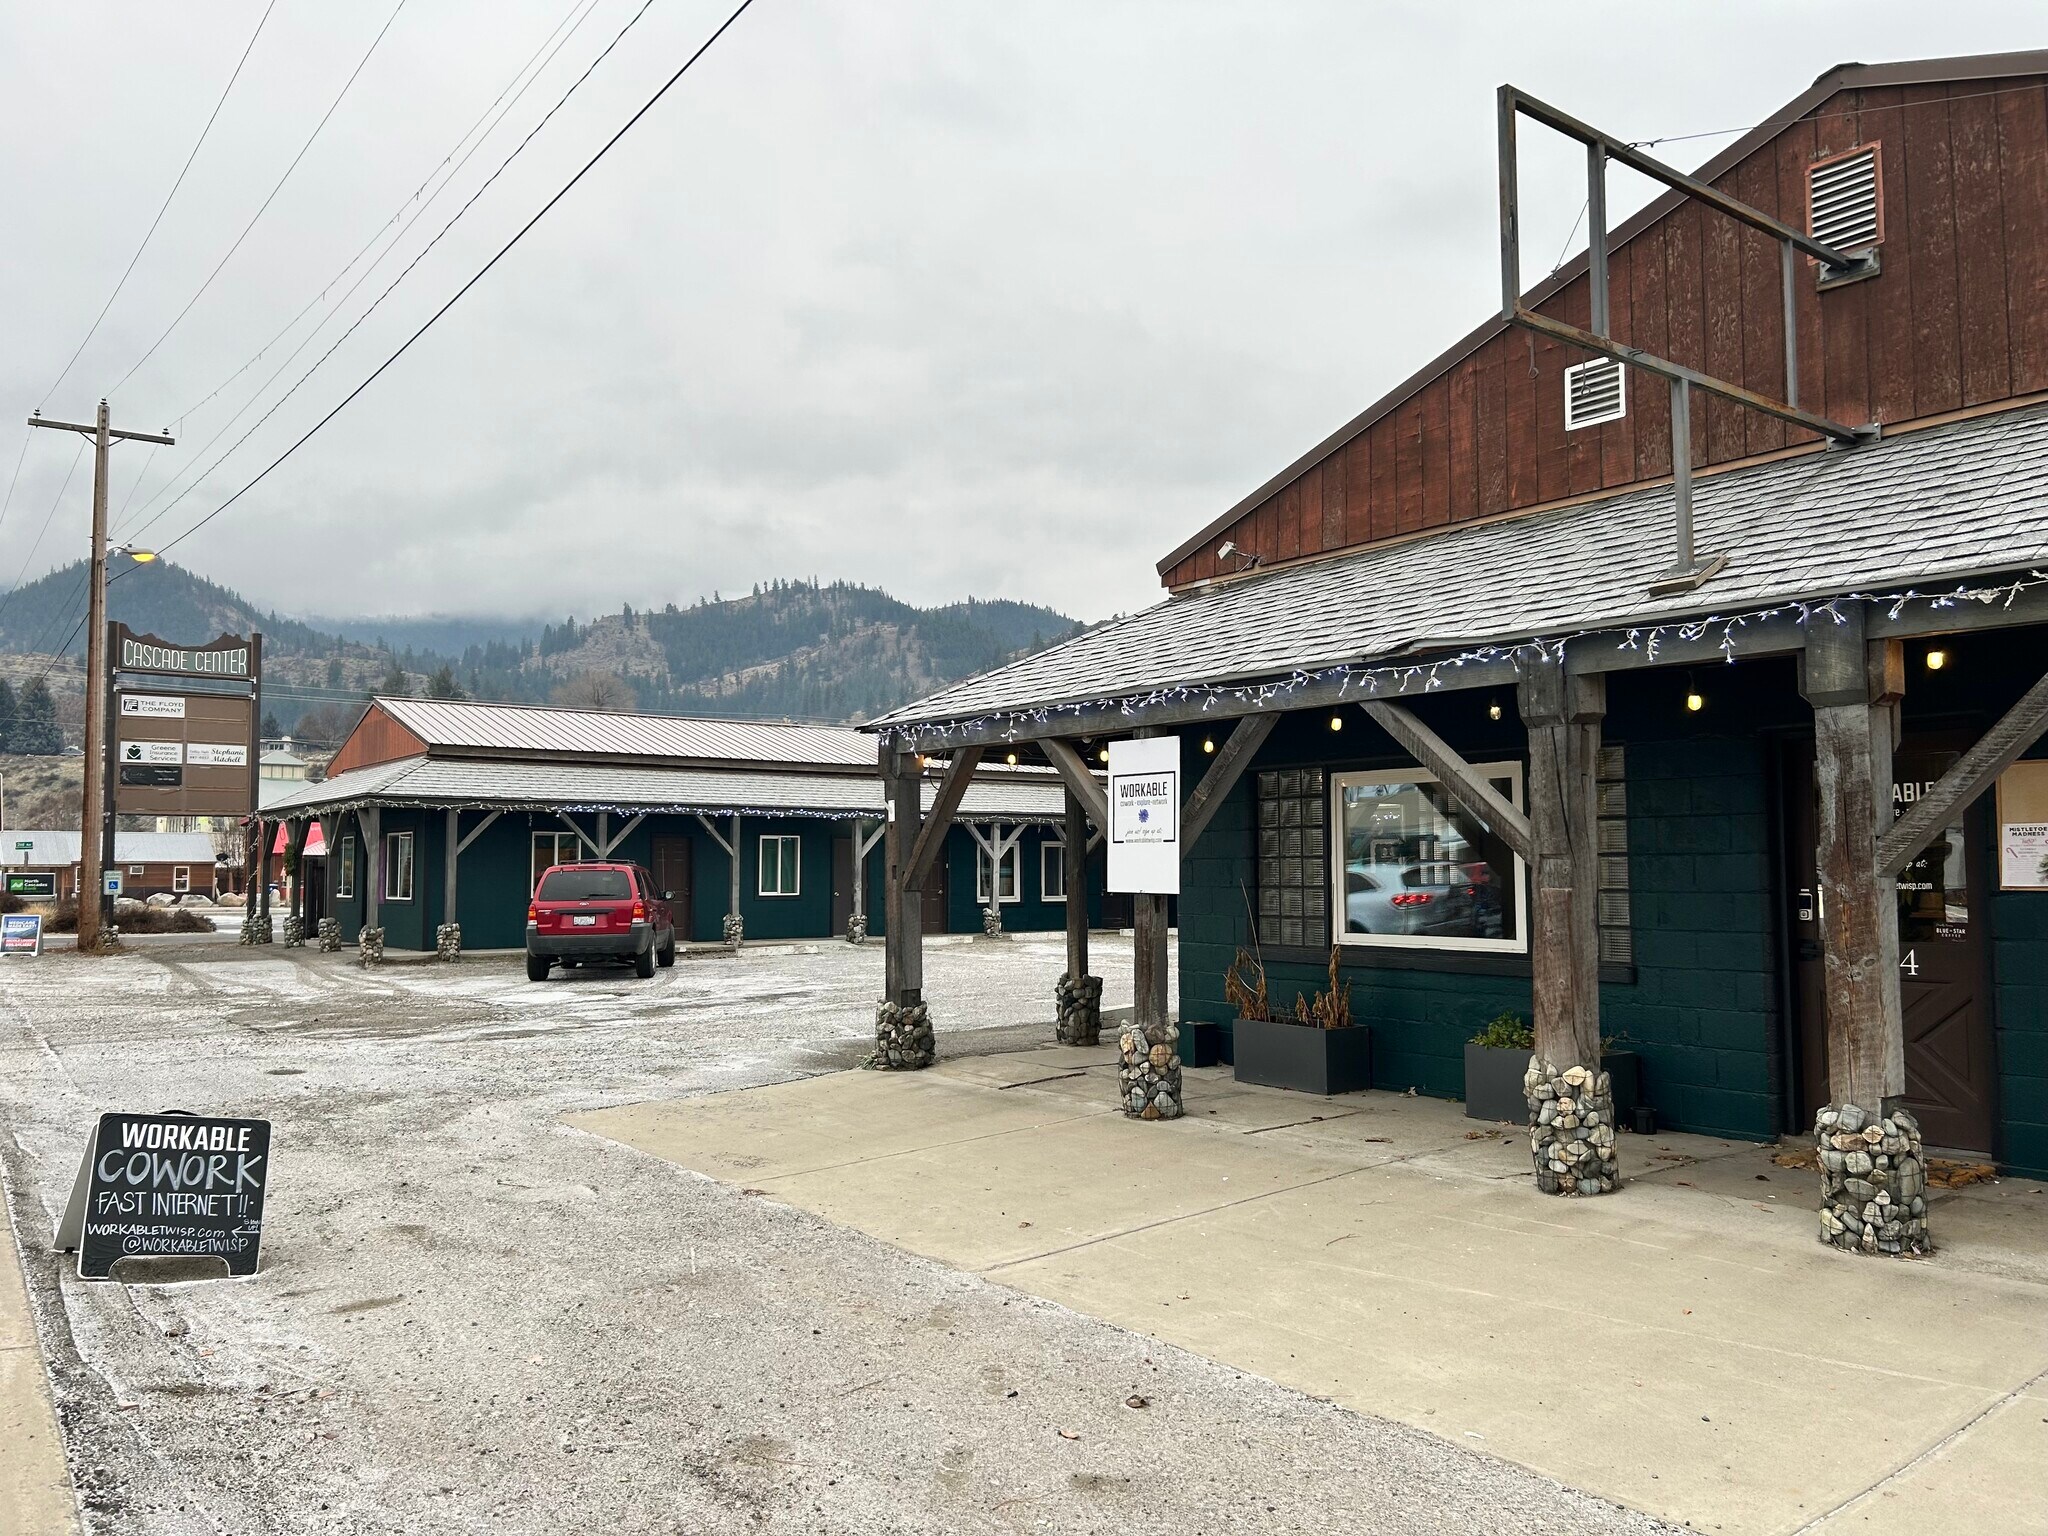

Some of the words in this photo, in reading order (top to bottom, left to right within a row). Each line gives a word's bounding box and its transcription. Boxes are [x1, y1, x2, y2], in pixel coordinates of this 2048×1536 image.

[124, 639, 189, 670] CASCADE
[195, 648, 247, 674] CENTER
[211, 748, 244, 756] Stephanie
[211, 755, 241, 763] Mitchell
[1120, 781, 1167, 798] WORKABLE
[1892, 782, 1934, 802] ABLE
[122, 1122, 252, 1152] WORKABLE
[98, 1149, 262, 1193] COWORK
[97, 1191, 147, 1215] FAST
[122, 1235, 249, 1254] @WORKABLETWISP
